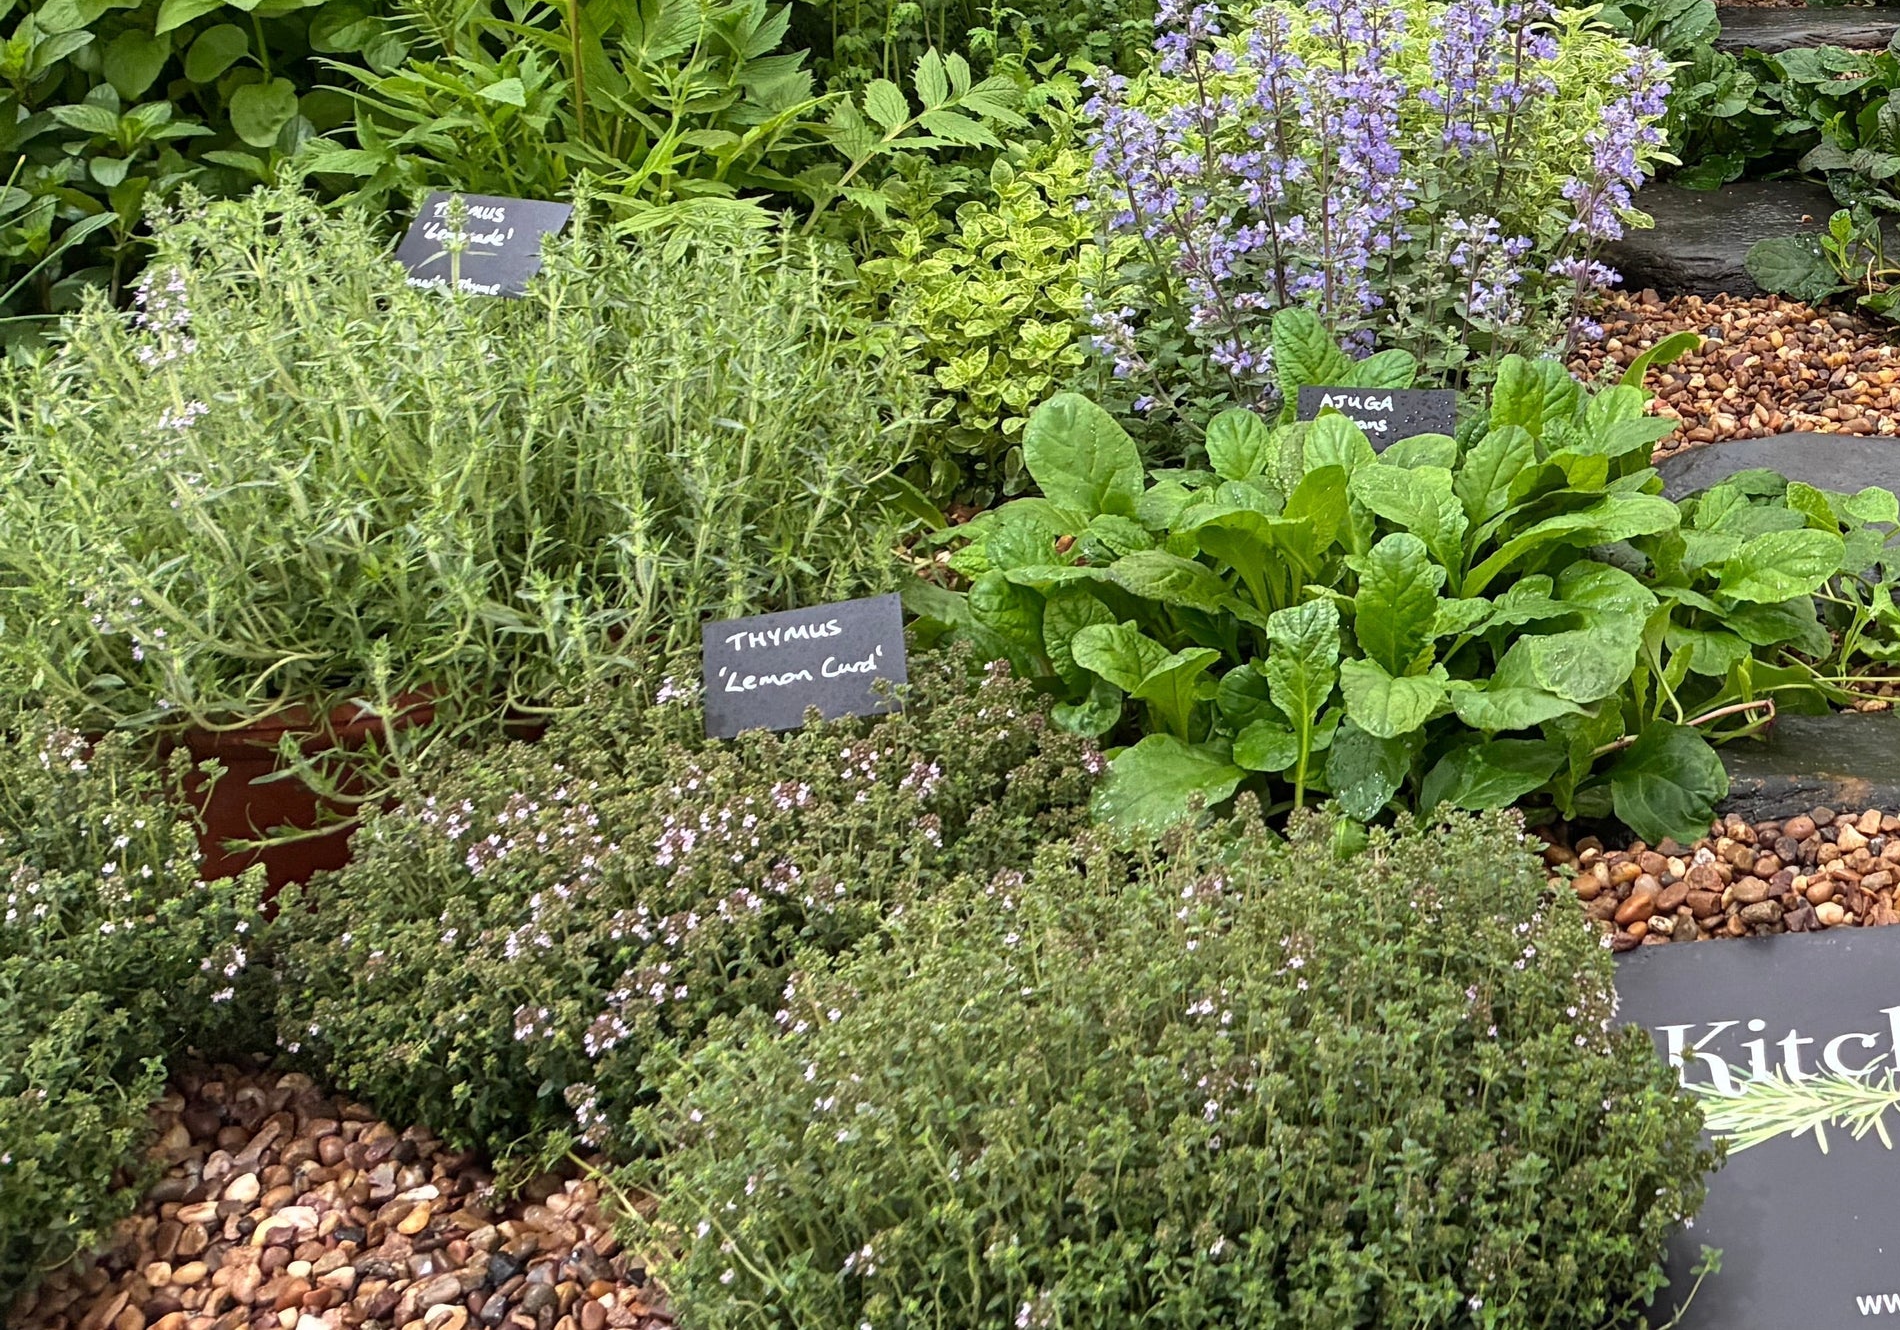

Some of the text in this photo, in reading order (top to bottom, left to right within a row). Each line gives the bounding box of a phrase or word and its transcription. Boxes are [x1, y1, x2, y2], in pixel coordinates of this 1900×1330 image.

[1319, 392, 1394, 412] AJUGA
[724, 618, 843, 652] THYMUS
[718, 666, 814, 693] 'Lemon
